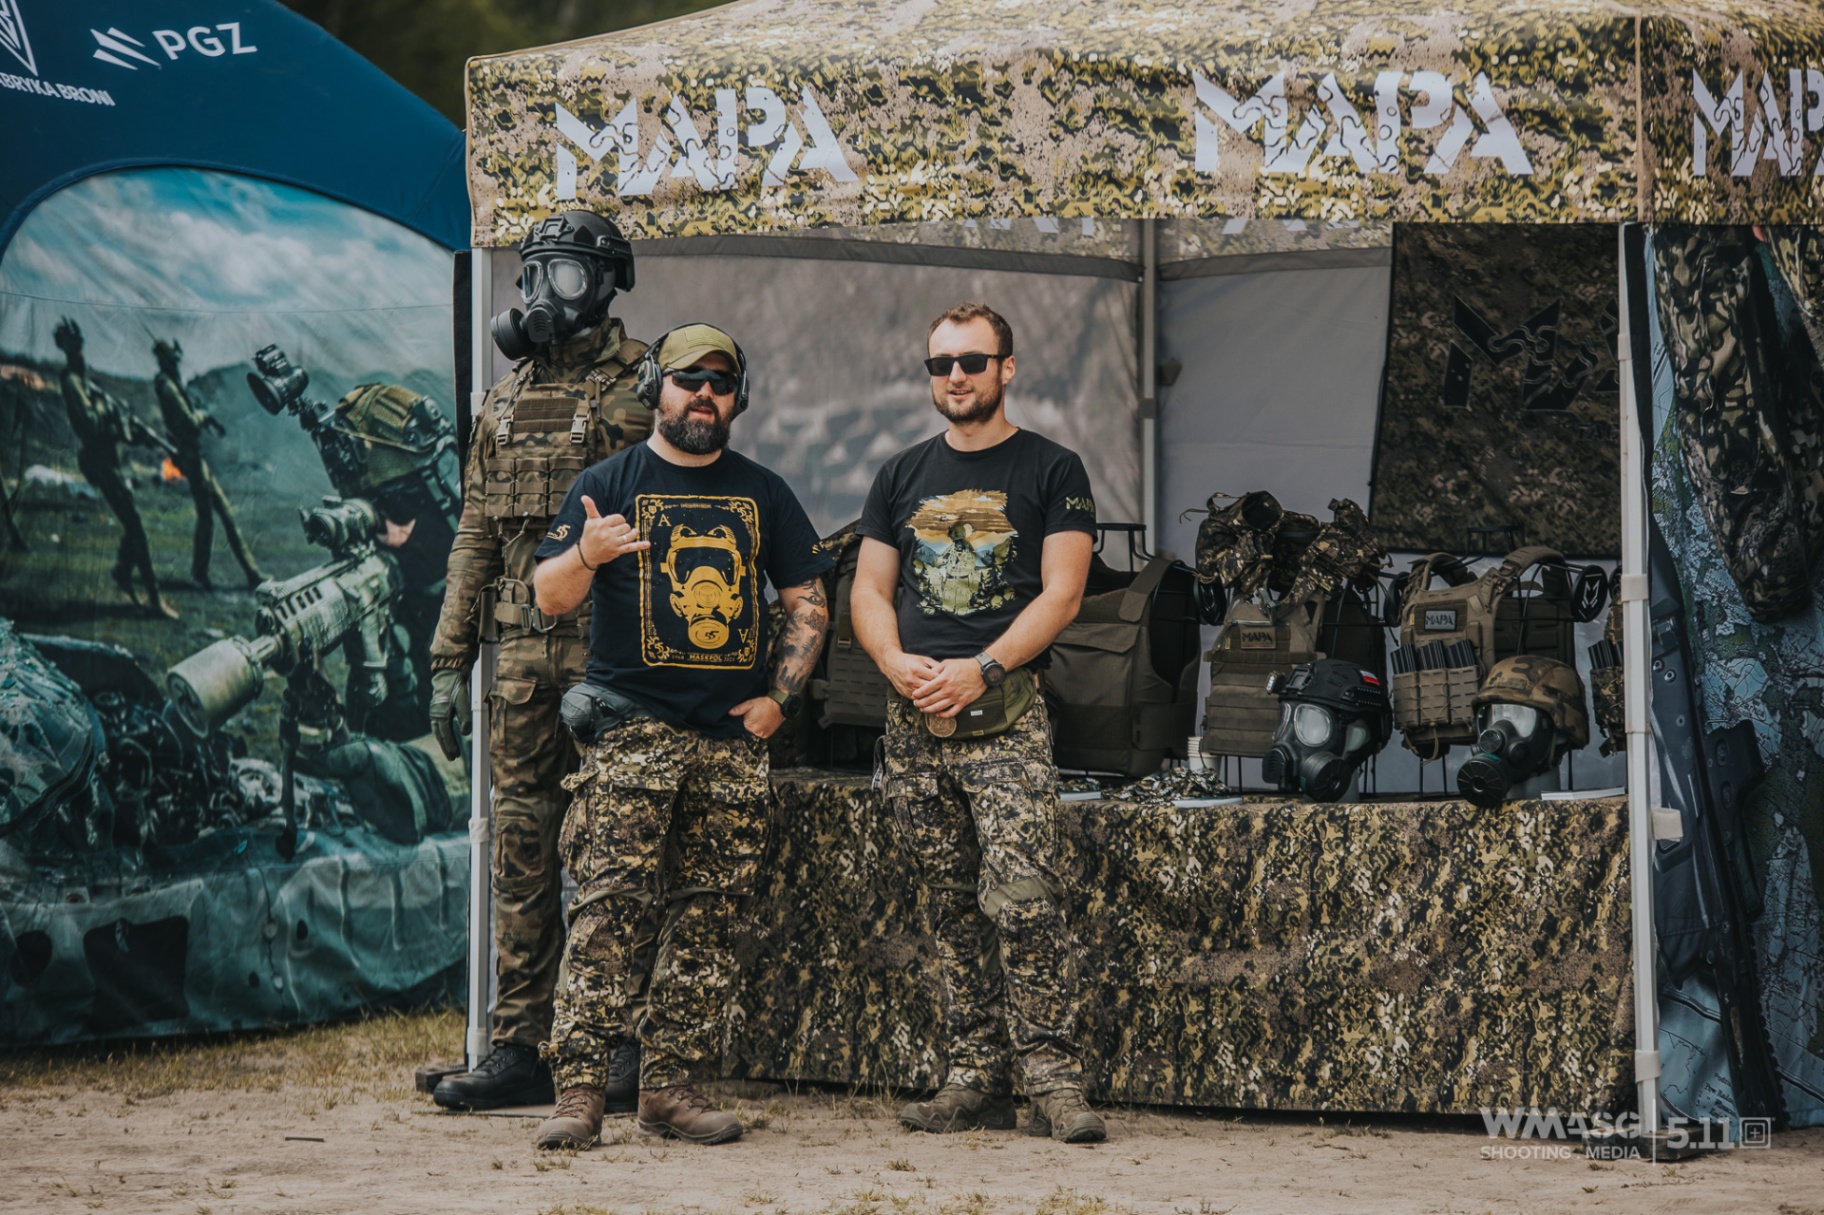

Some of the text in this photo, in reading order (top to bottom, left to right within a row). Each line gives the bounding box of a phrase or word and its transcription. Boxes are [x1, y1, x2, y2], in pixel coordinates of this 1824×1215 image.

[152, 22, 258, 61] PGZ
[56, 83, 116, 107] BRONI
[1193, 69, 1534, 175] MAPA
[554, 86, 859, 201] MAPA
[657, 513, 672, 527] A
[1426, 614, 1454, 626] MAPA
[1242, 631, 1273, 642] MAPA
